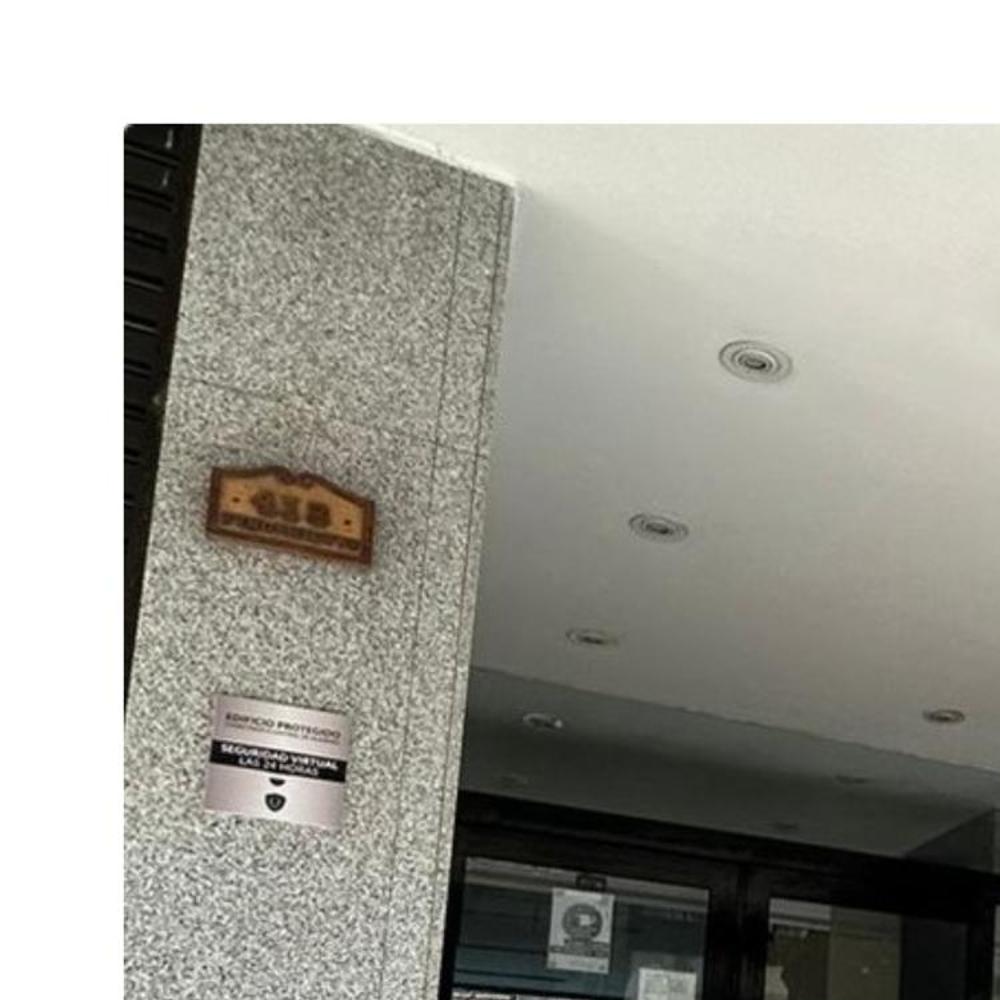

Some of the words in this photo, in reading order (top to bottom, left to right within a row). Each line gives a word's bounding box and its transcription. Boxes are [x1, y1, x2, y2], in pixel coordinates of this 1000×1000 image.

[225, 711, 275, 728] EDIFICIO
[277, 721, 342, 739] PROTEGIDO
[221, 743, 289, 763] SEGURIDAD
[290, 754, 339, 770] VIRTUAL
[263, 759, 278, 770] 24
[279, 763, 319, 777] HORAS
